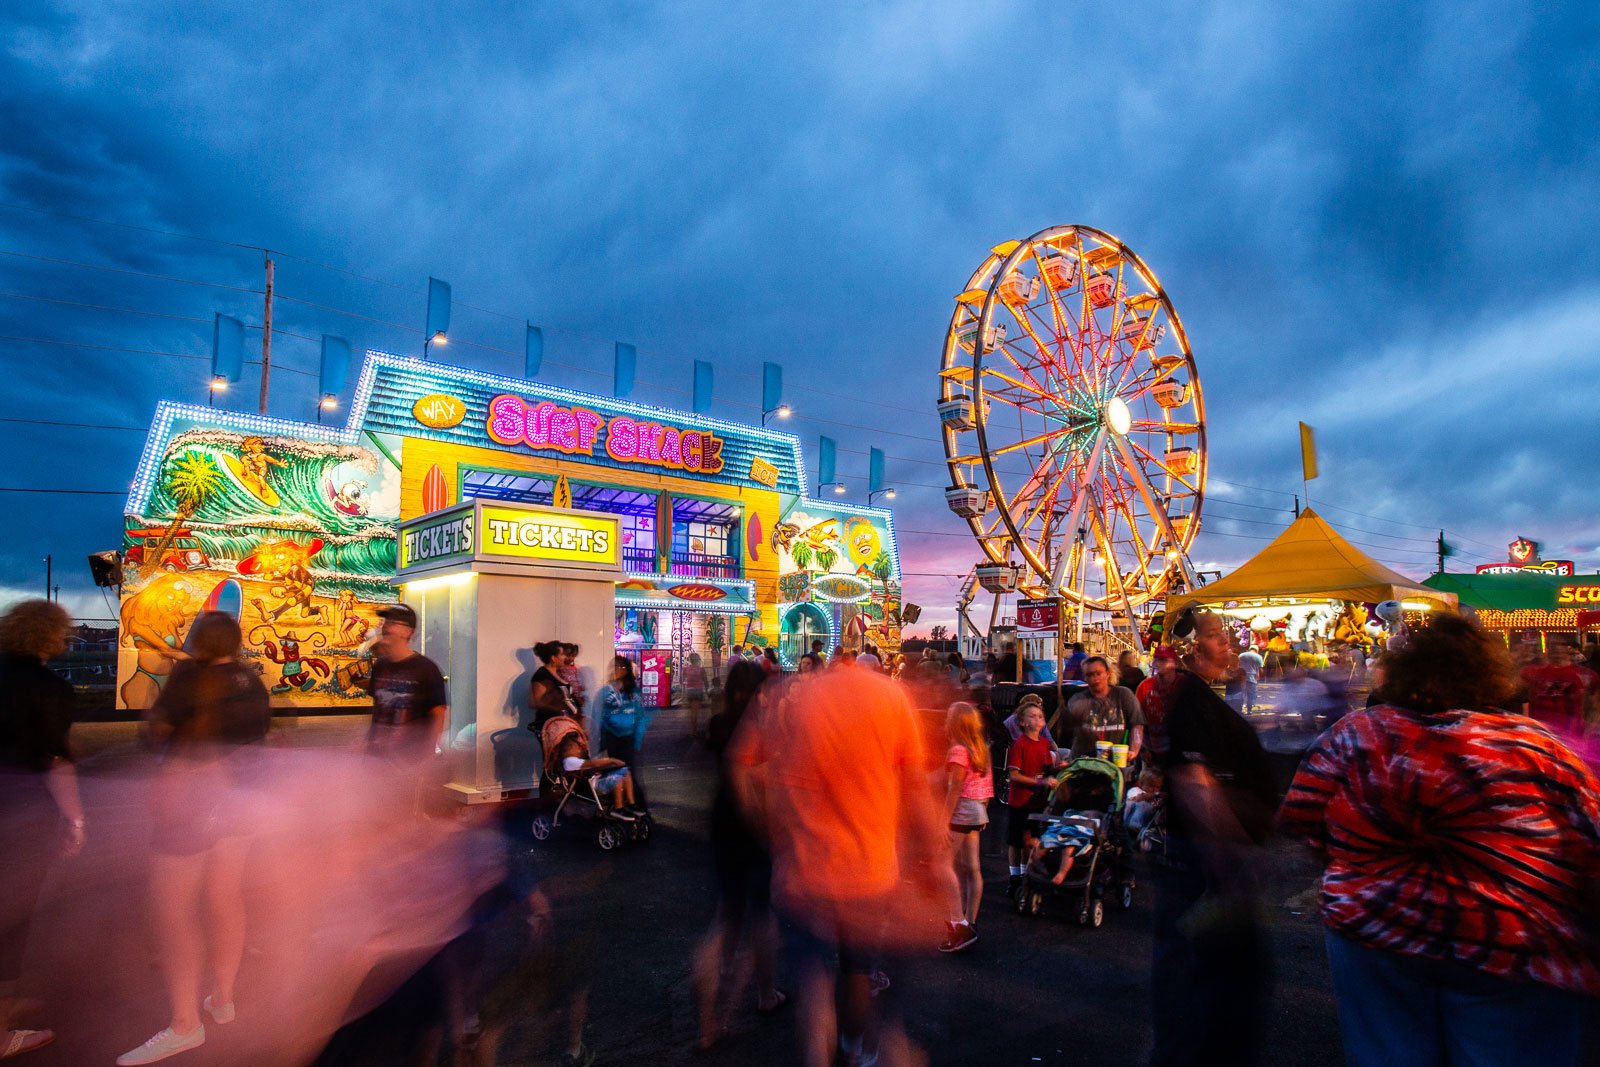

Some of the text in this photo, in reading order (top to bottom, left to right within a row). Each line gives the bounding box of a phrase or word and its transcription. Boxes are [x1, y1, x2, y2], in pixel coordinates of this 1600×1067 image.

[421, 399, 457, 420] WAX
[490, 397, 723, 470] SURF SHACK
[405, 515, 473, 563] TICKETS
[488, 519, 608, 553] TICKETS
